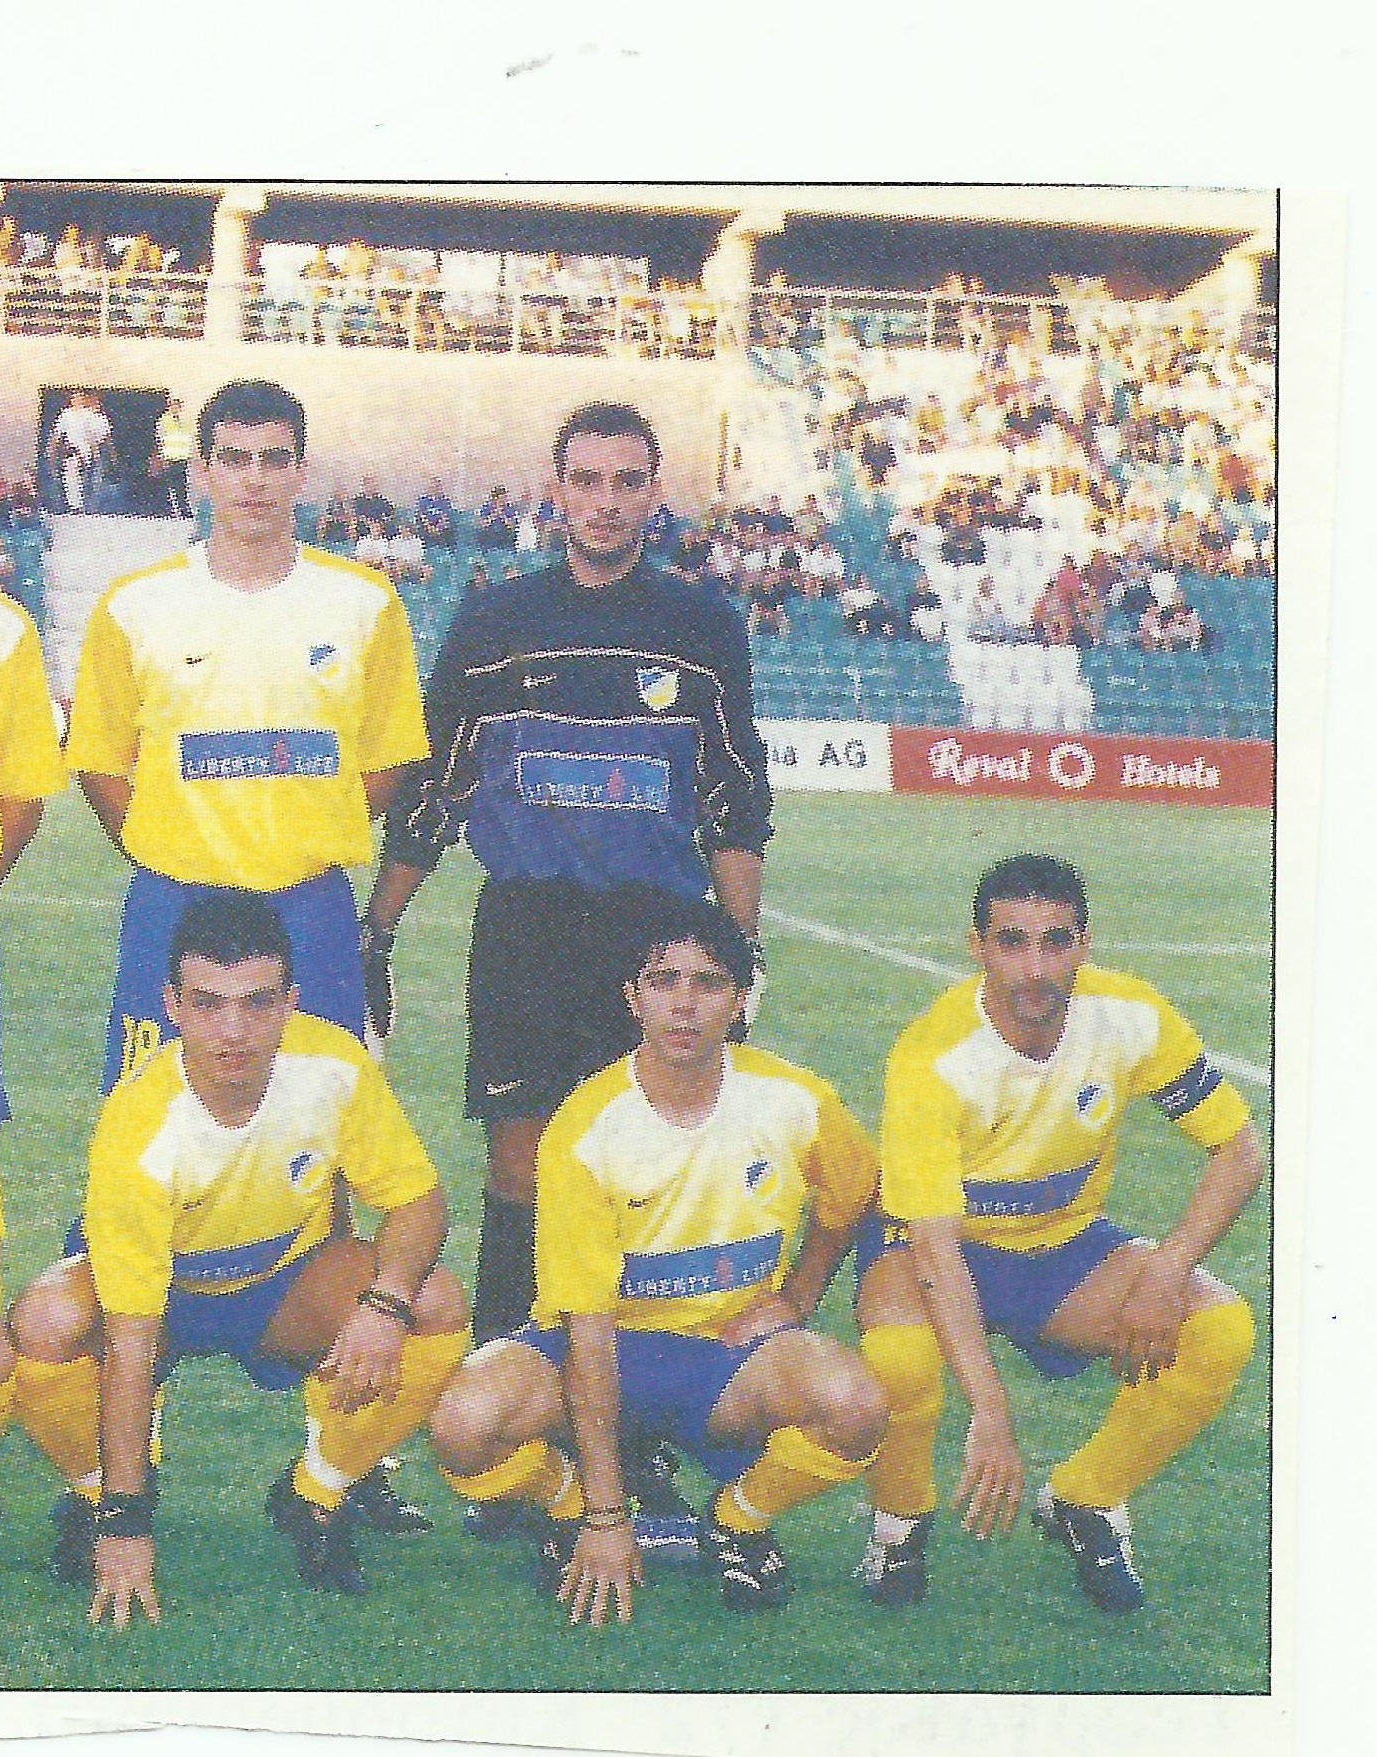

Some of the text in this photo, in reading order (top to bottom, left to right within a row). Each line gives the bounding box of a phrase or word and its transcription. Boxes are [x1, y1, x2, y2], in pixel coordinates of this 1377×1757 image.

[186, 756, 334, 776] LIBERTY LIFE
[818, 738, 868, 769] AG
[927, 737, 1221, 790] Reval Hotels
[625, 1276, 711, 1297] LIBERTY
